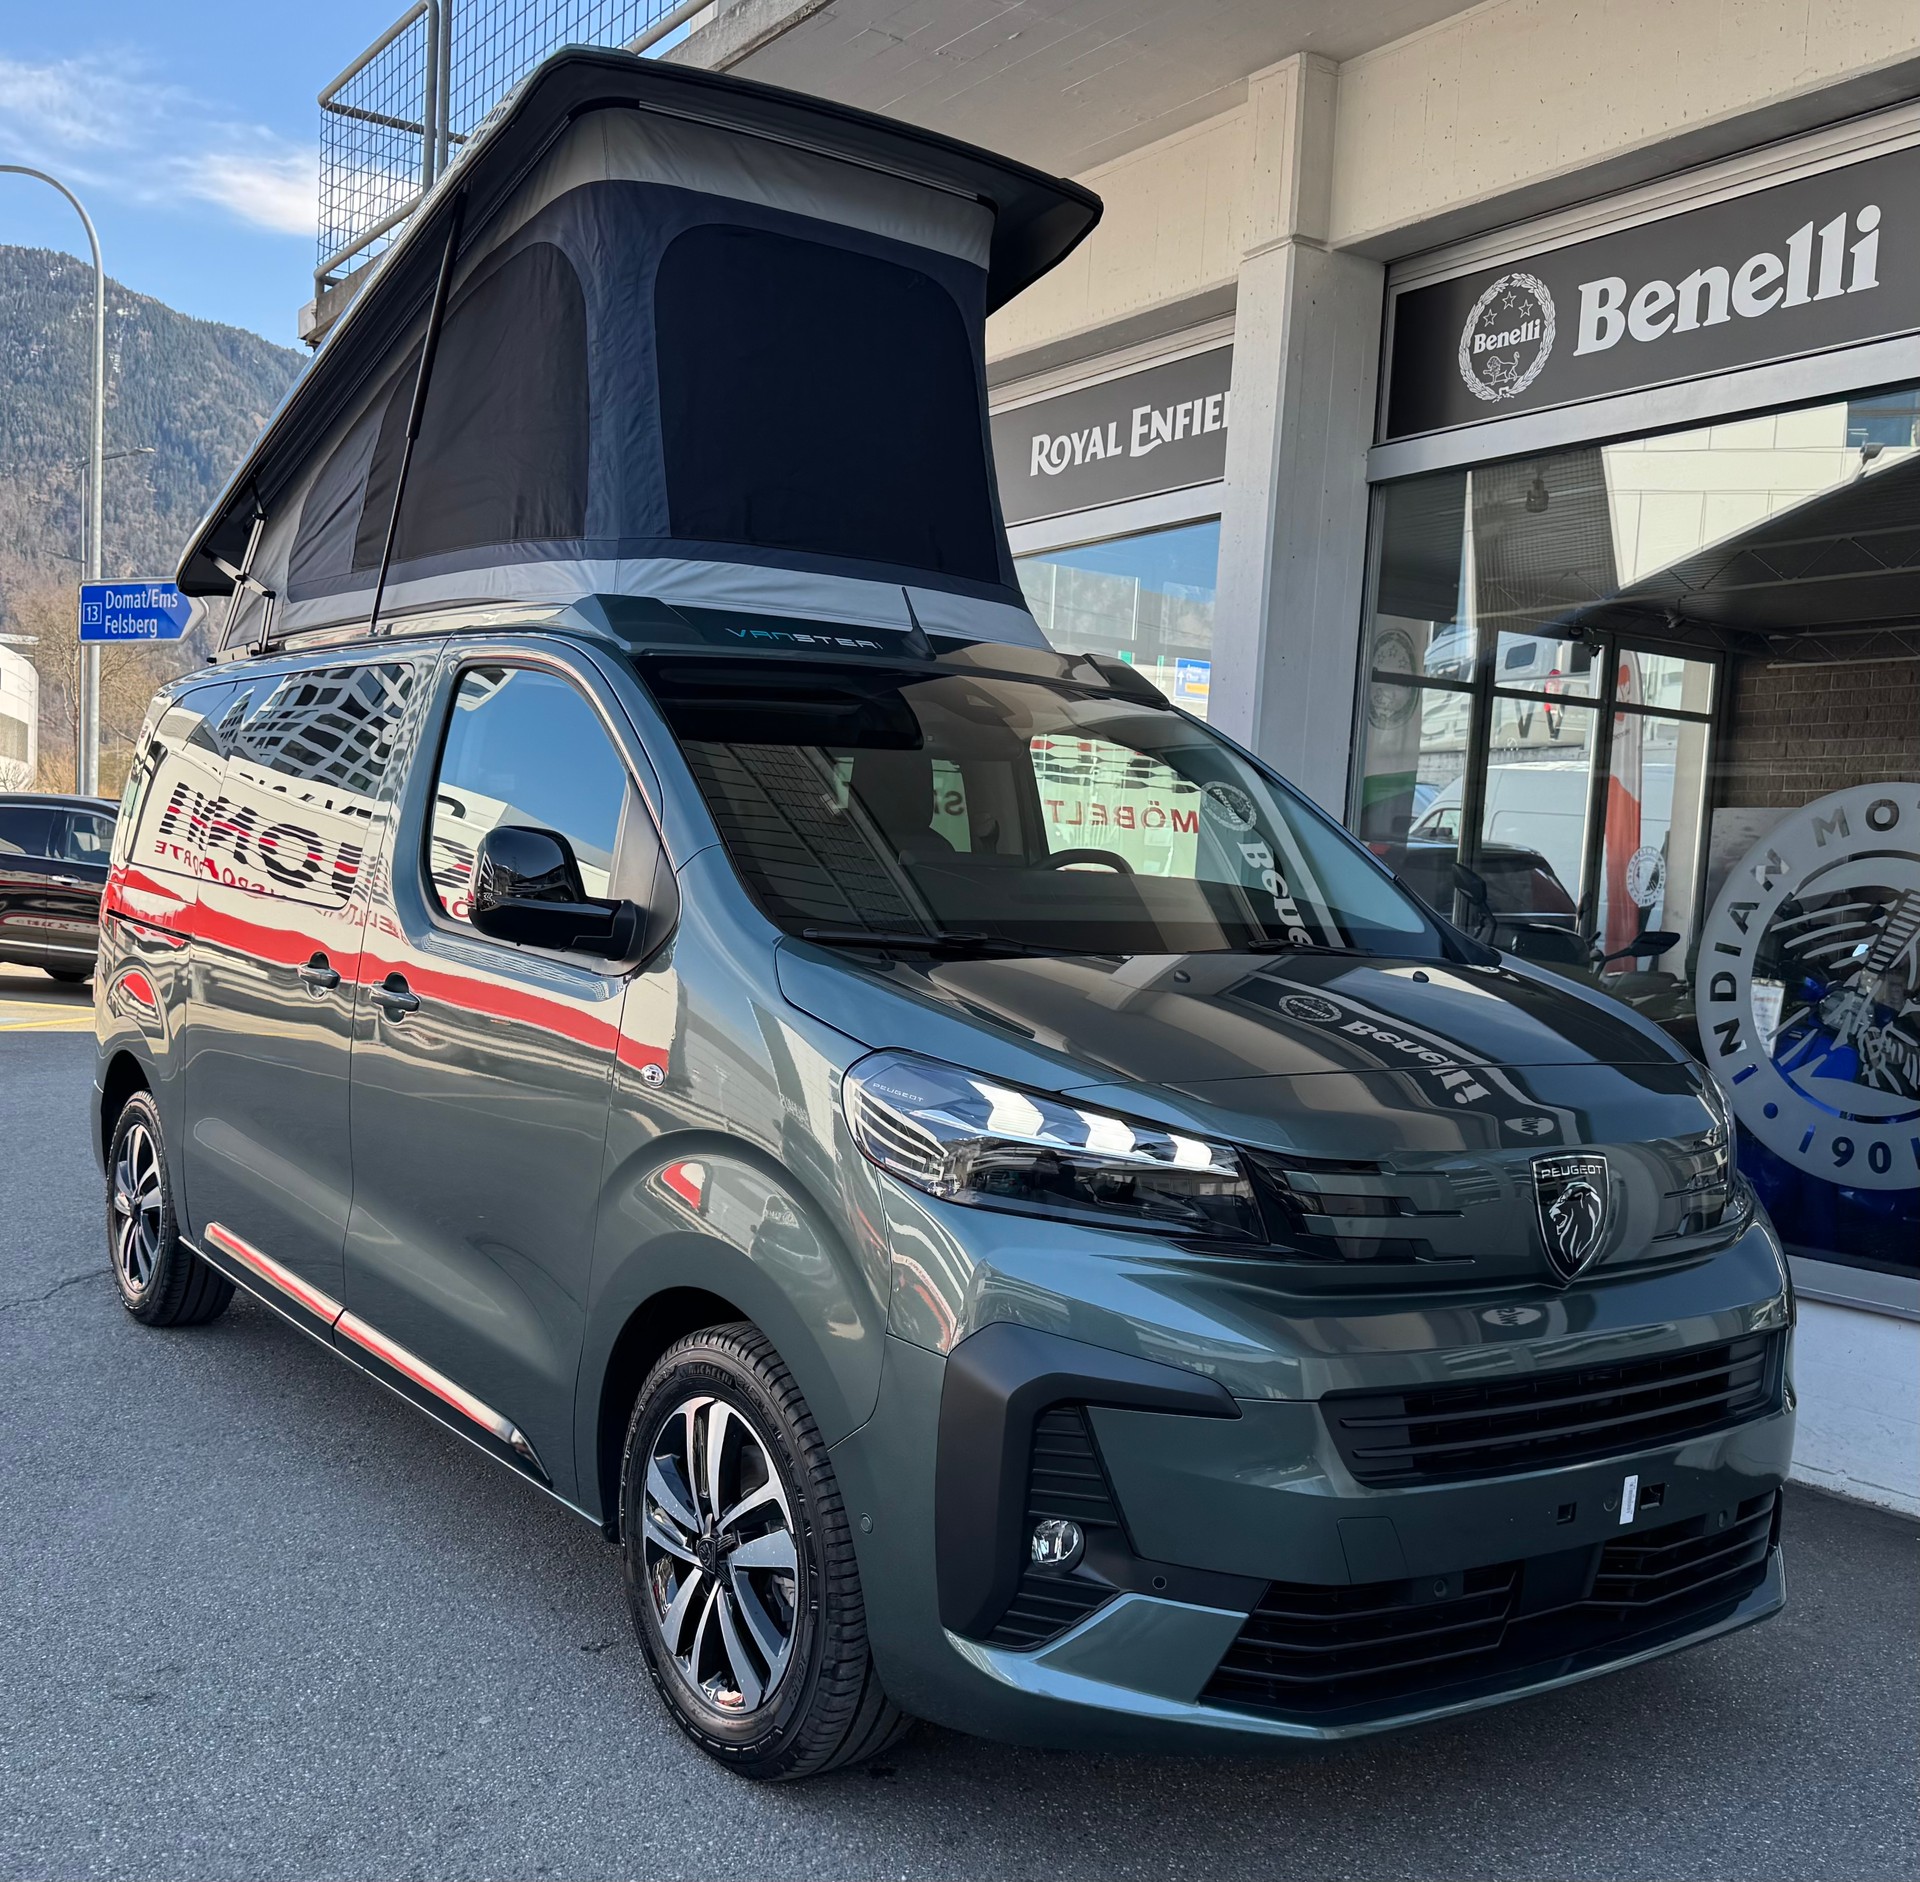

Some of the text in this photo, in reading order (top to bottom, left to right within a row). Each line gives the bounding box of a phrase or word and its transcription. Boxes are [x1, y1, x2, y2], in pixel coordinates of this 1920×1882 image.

[1573, 204, 1881, 357] Benelli
[1473, 319, 1541, 354] Benelli
[1030, 421, 1123, 477] ROYAL
[105, 588, 179, 610] Domat/Ems
[86, 605, 99, 621] 13
[104, 613, 158, 639] Felsberg
[1710, 798, 1920, 1085] INDIAN MO
[873, 1082, 924, 1102] PEUGEOT
[1541, 1164, 1603, 1179] PEUGEOT
